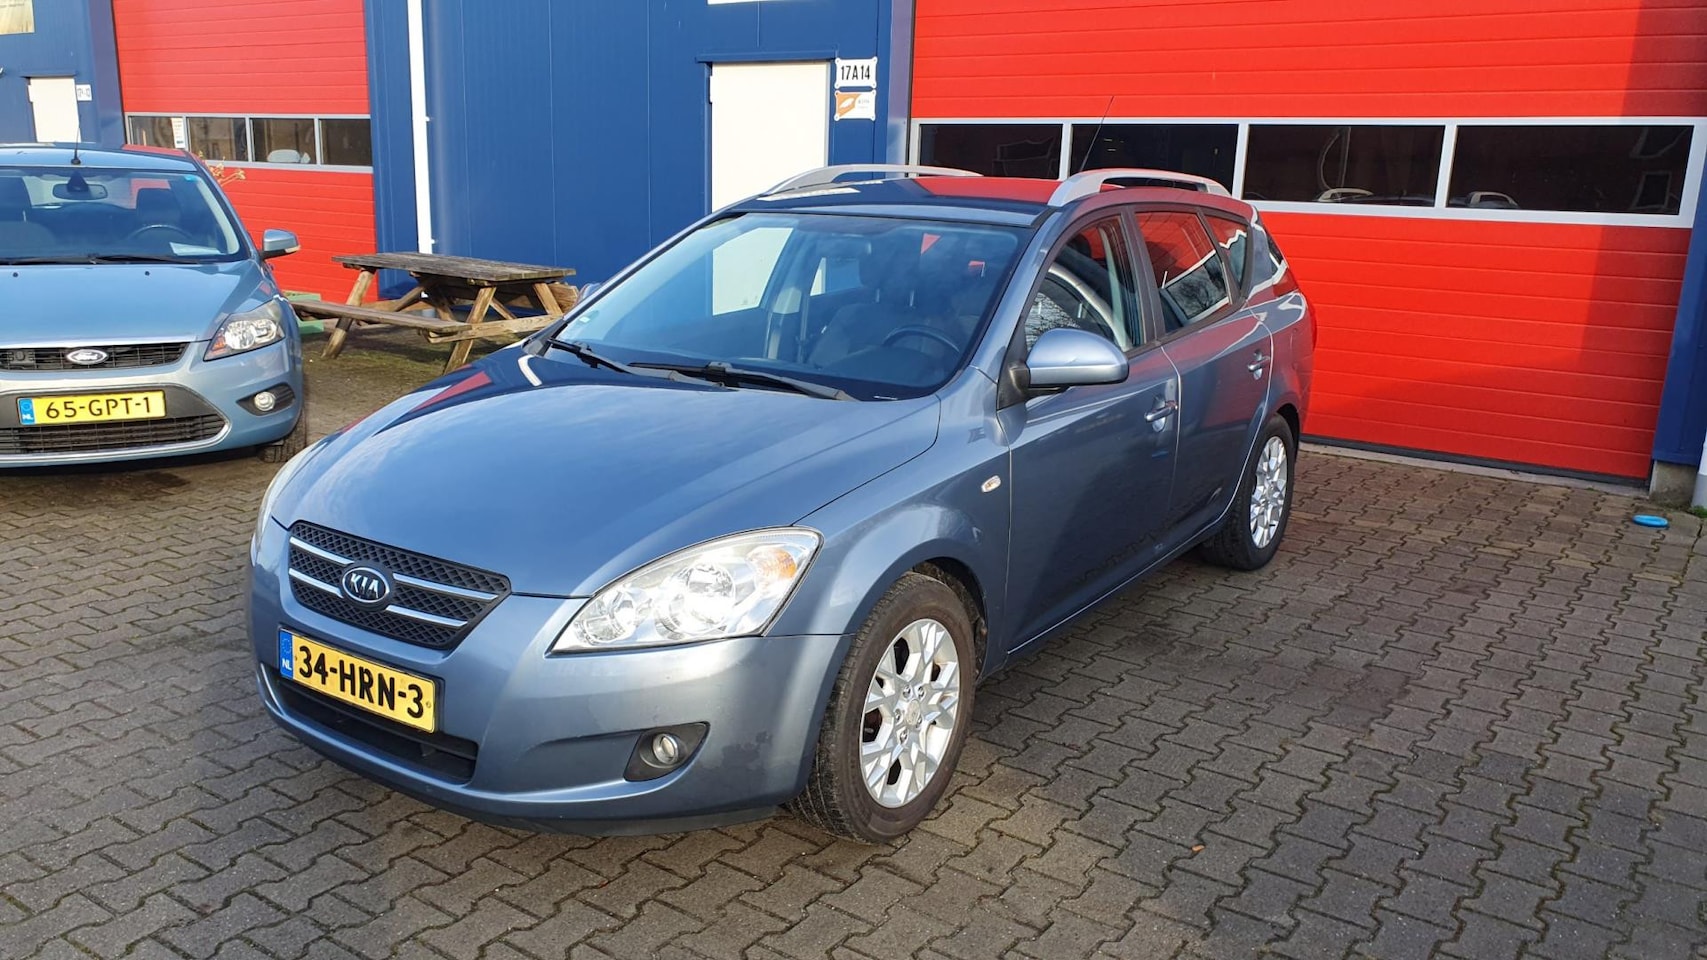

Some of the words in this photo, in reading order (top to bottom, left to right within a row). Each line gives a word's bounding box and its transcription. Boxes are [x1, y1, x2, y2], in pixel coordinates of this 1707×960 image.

[841, 65, 870, 80] 17A14
[46, 397, 150, 418] 65-GPT-1
[350, 573, 379, 598] KIA
[282, 658, 292, 670] NL
[299, 645, 424, 718] 34-HRN-3
